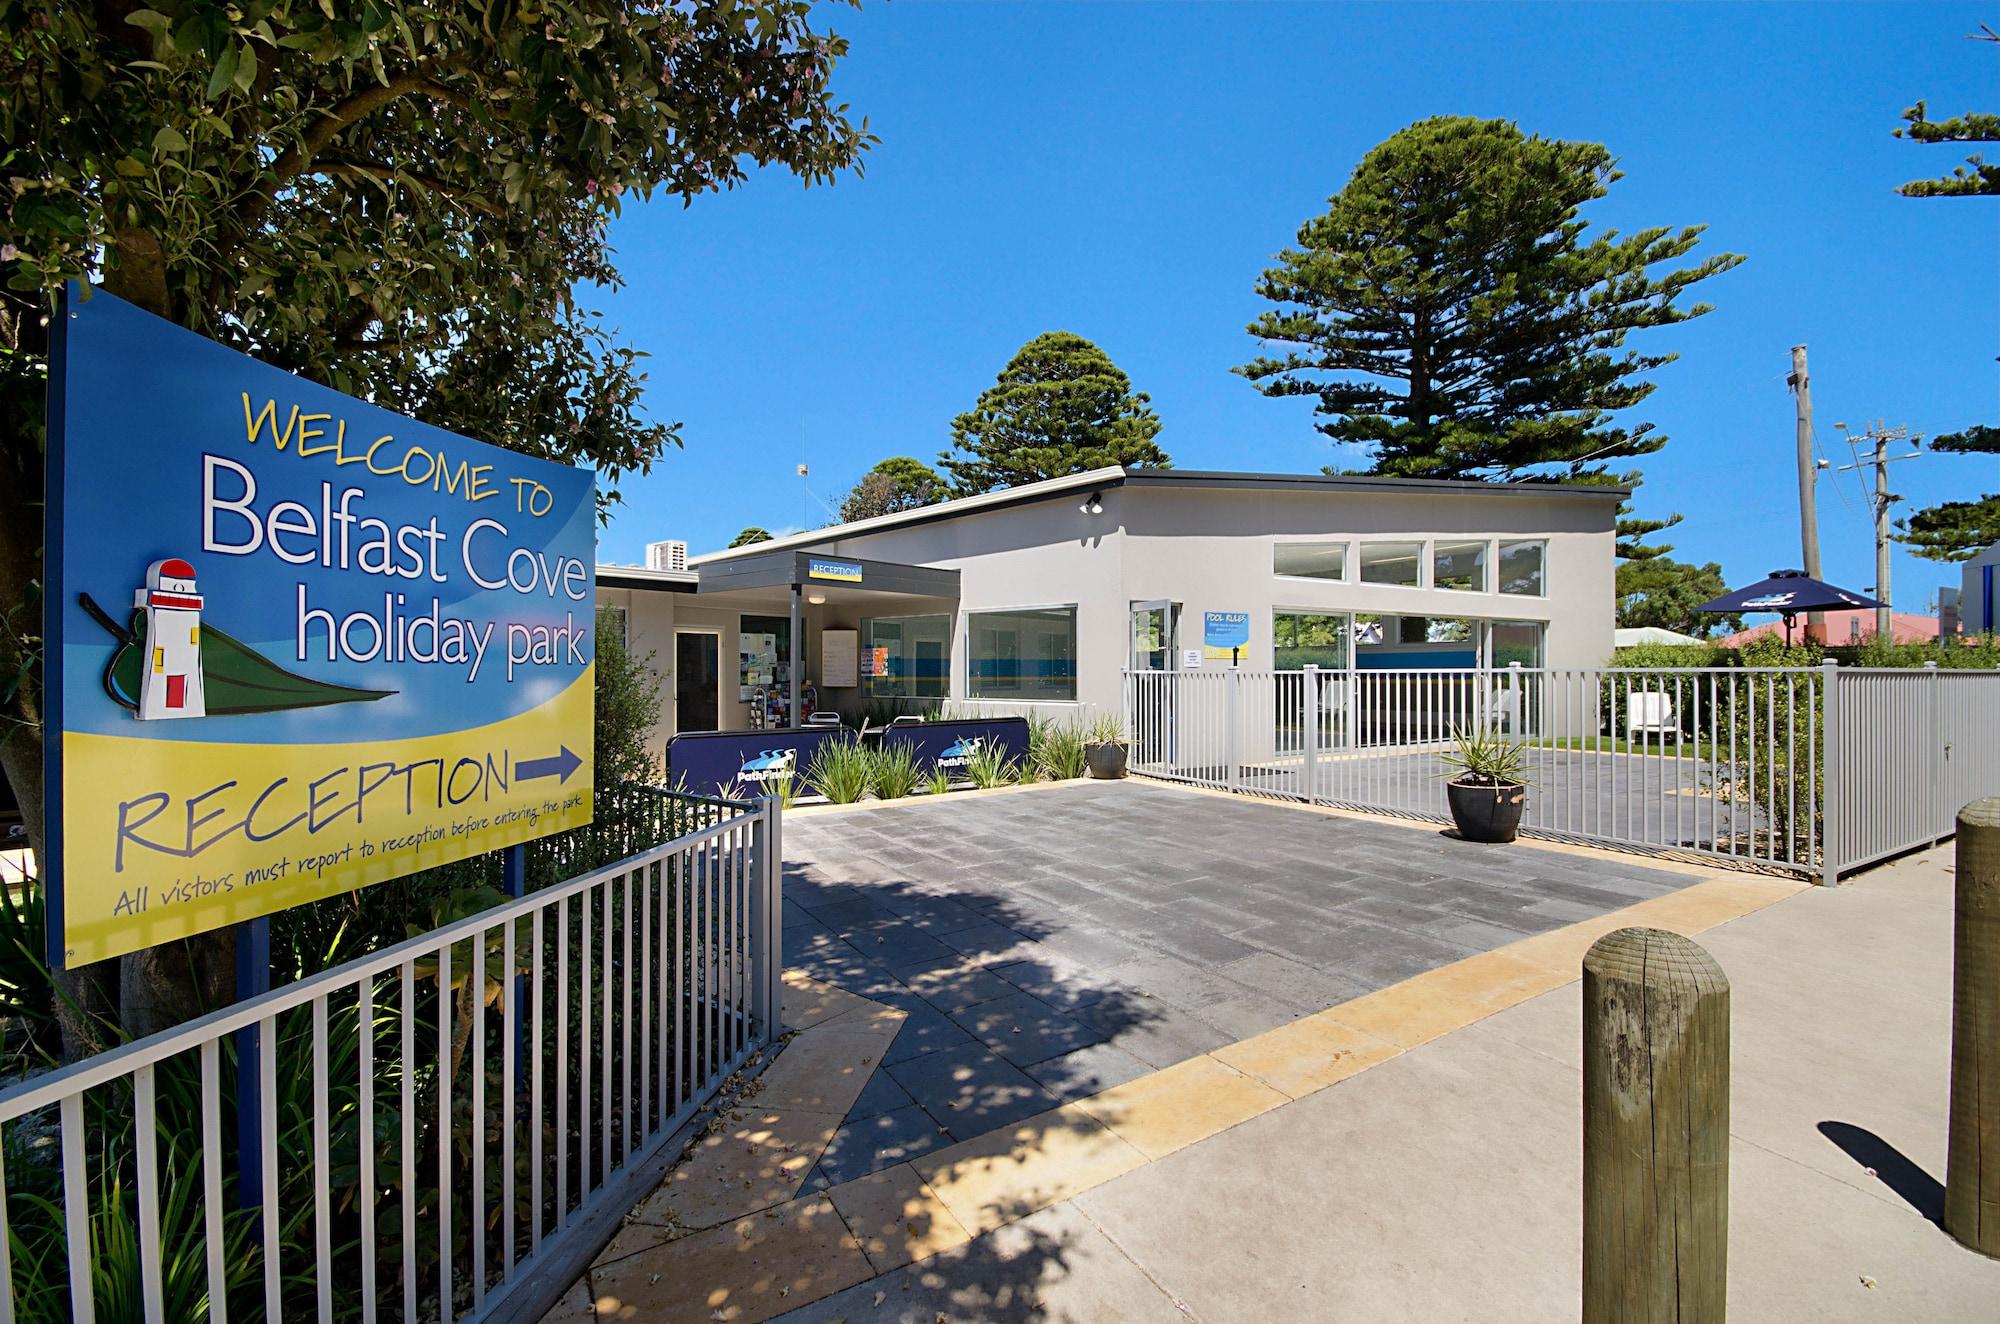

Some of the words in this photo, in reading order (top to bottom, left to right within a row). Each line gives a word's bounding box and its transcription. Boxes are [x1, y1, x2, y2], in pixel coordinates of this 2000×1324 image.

[242, 392, 499, 501] WELCOME
[510, 478, 553, 517] TO
[202, 453, 448, 583] Belfast
[461, 518, 588, 601] Cove
[813, 564, 859, 577] RECEPTION
[297, 583, 495, 683] holiday
[507, 612, 587, 682] park
[1206, 613, 1224, 621] POOL
[1226, 614, 1246, 623] RULES
[113, 886, 148, 916] All
[161, 873, 234, 902] vistors
[245, 857, 290, 886] must
[298, 843, 353, 878] report
[359, 839, 375, 858] to
[382, 824, 446, 853] reception
[451, 815, 490, 839] before
[494, 806, 540, 827] entering
[543, 800, 560, 813] the
[562, 794, 583, 816] park
[115, 749, 509, 872] RECEPTION
